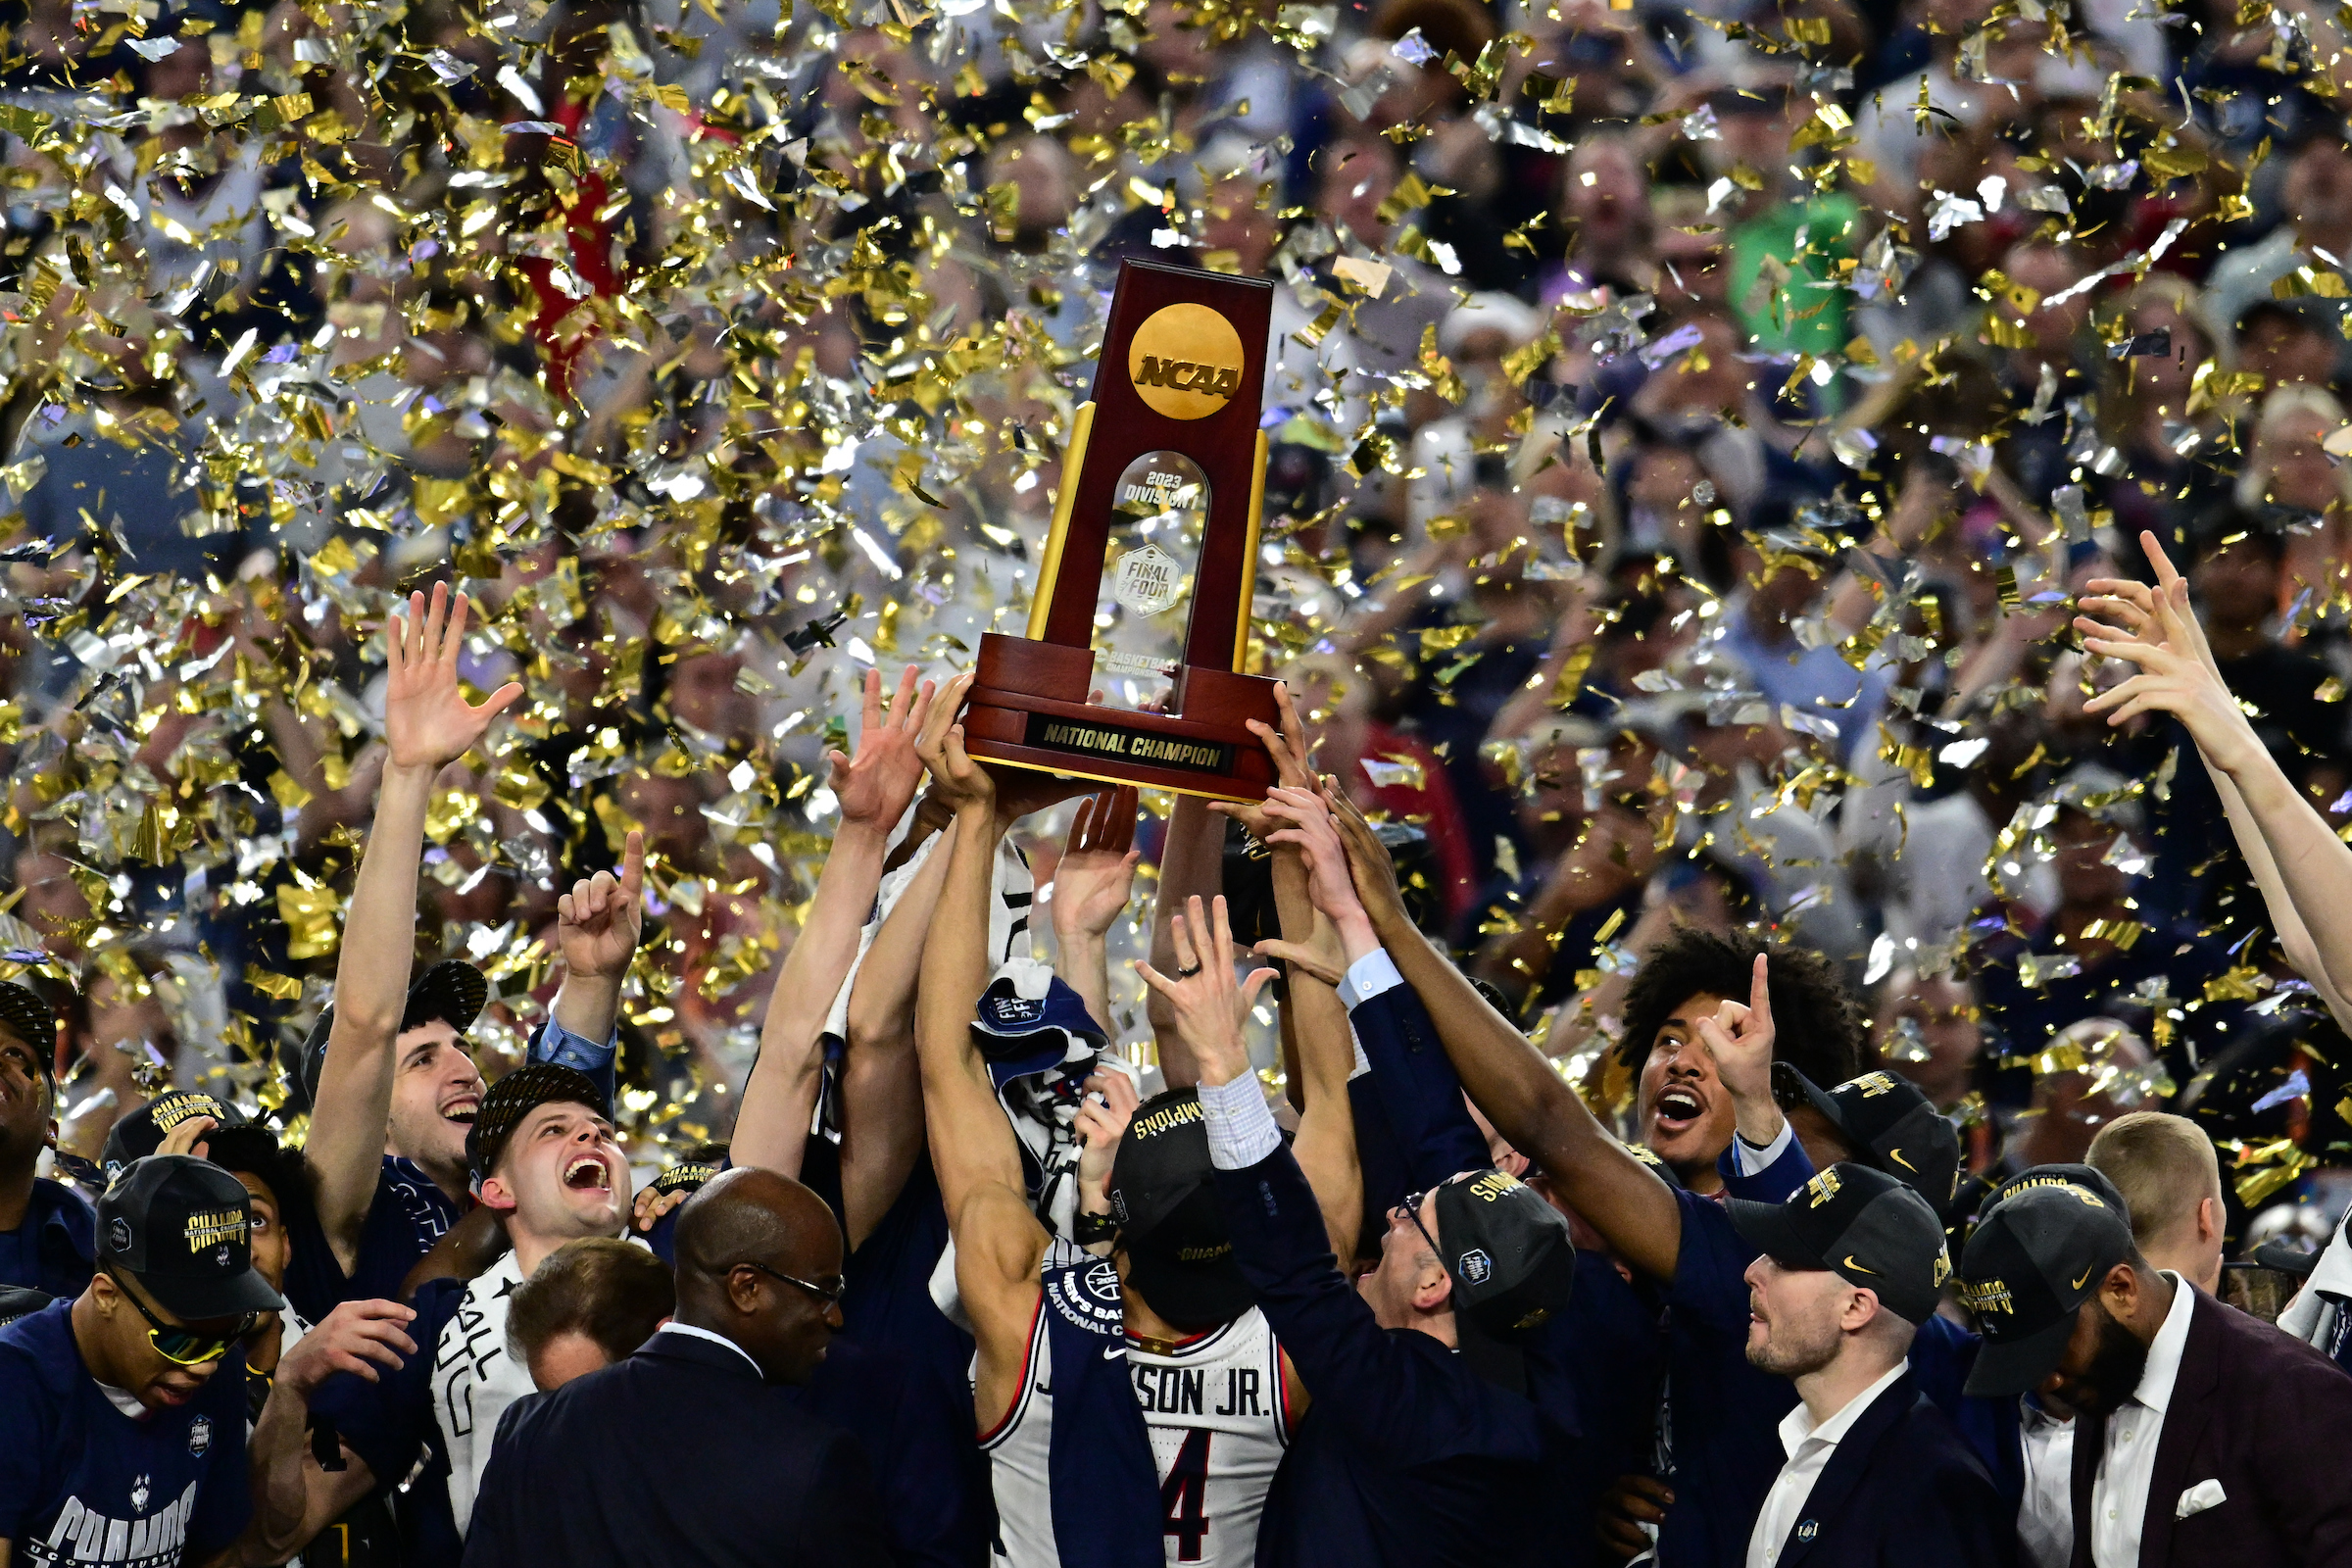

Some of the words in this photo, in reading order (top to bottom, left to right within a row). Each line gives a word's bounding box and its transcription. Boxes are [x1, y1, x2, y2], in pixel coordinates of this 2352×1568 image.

[1135, 354, 1238, 400] NCAA
[1146, 471, 1182, 489] 2023
[1124, 484, 1190, 509] DIVISION
[1127, 562, 1168, 582] FINAL
[1128, 579, 1169, 598] FOUR
[1106, 662, 1163, 678] CHAMPIONSHIP
[1108, 652, 1176, 672] BASKETBALL
[1044, 723, 1126, 754] NATIONAL
[1130, 737, 1222, 767] CHAMPION
[659, 1165, 716, 1188] CHAMP
[1063, 1271, 1093, 1313] MEN'S
[1048, 1282, 1108, 1335] NATIONAL
[1215, 1368, 1270, 1416] JR.
